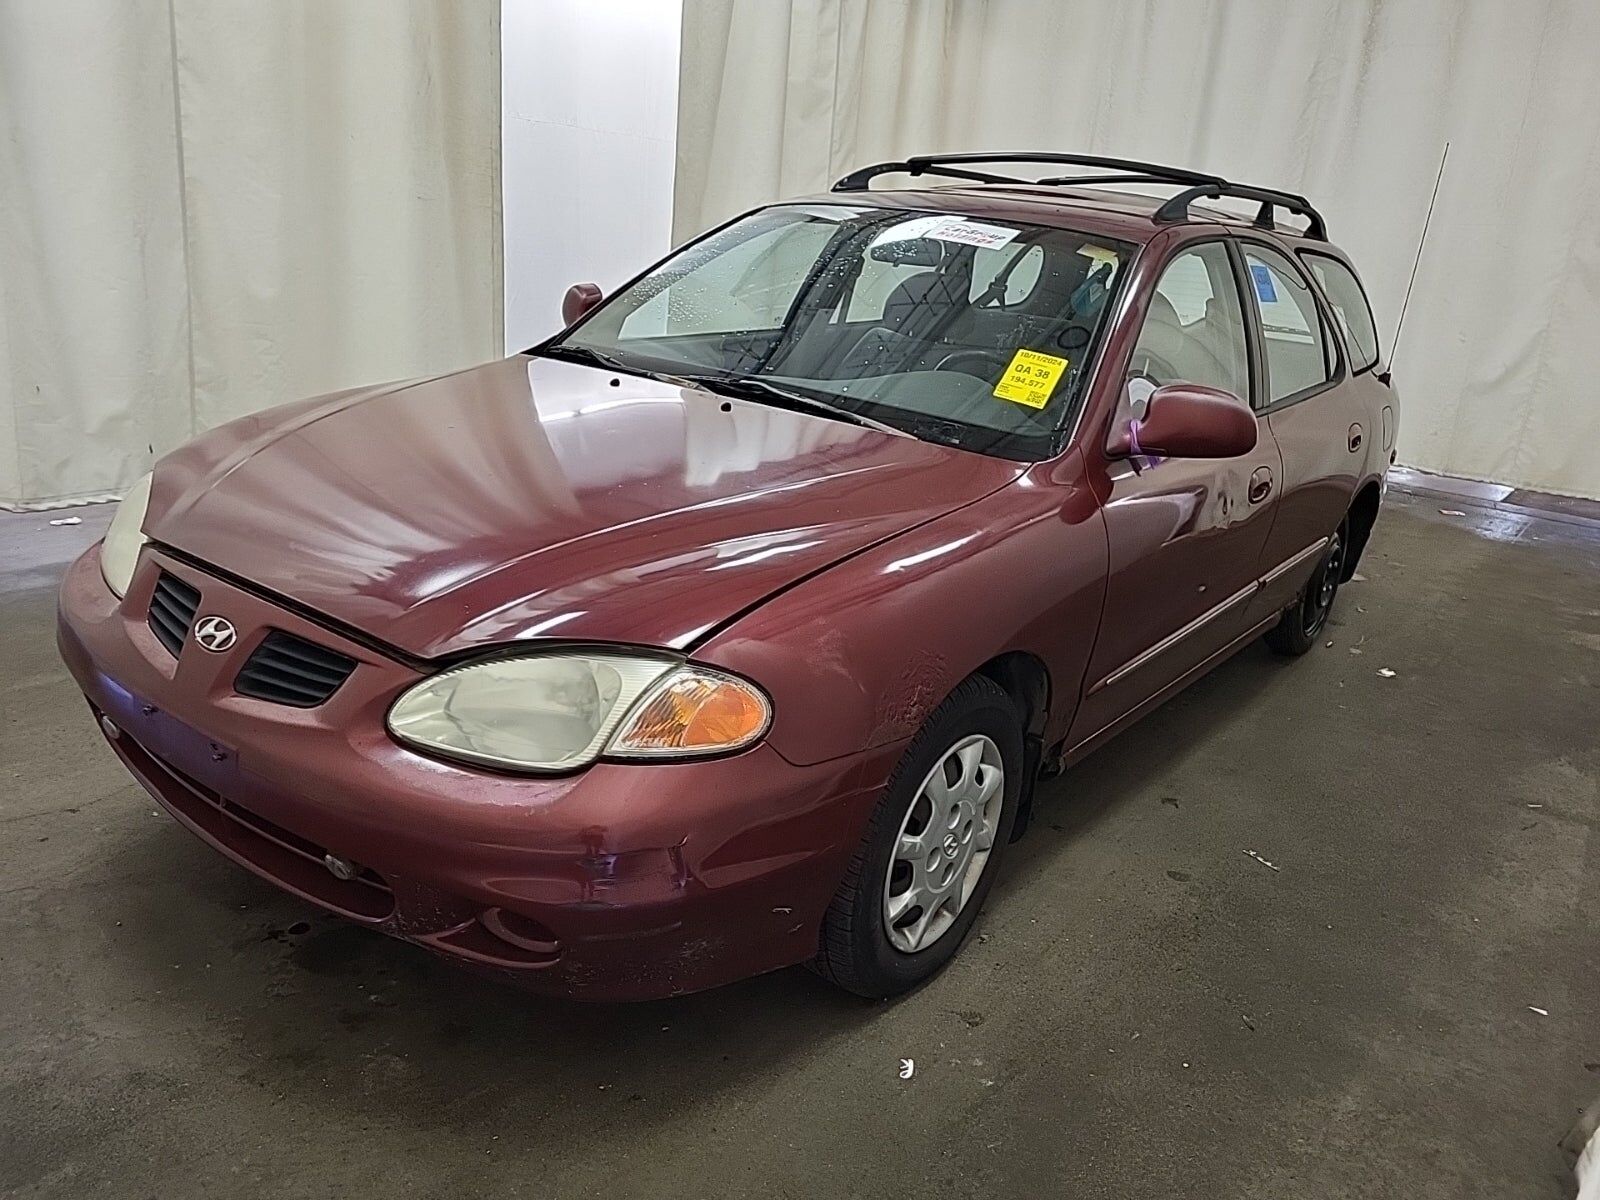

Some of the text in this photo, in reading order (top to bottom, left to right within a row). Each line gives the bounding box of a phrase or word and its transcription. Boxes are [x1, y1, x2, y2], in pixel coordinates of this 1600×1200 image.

[1019, 351, 1063, 366] 10/11/2024
[1014, 364, 1050, 379] QA 38
